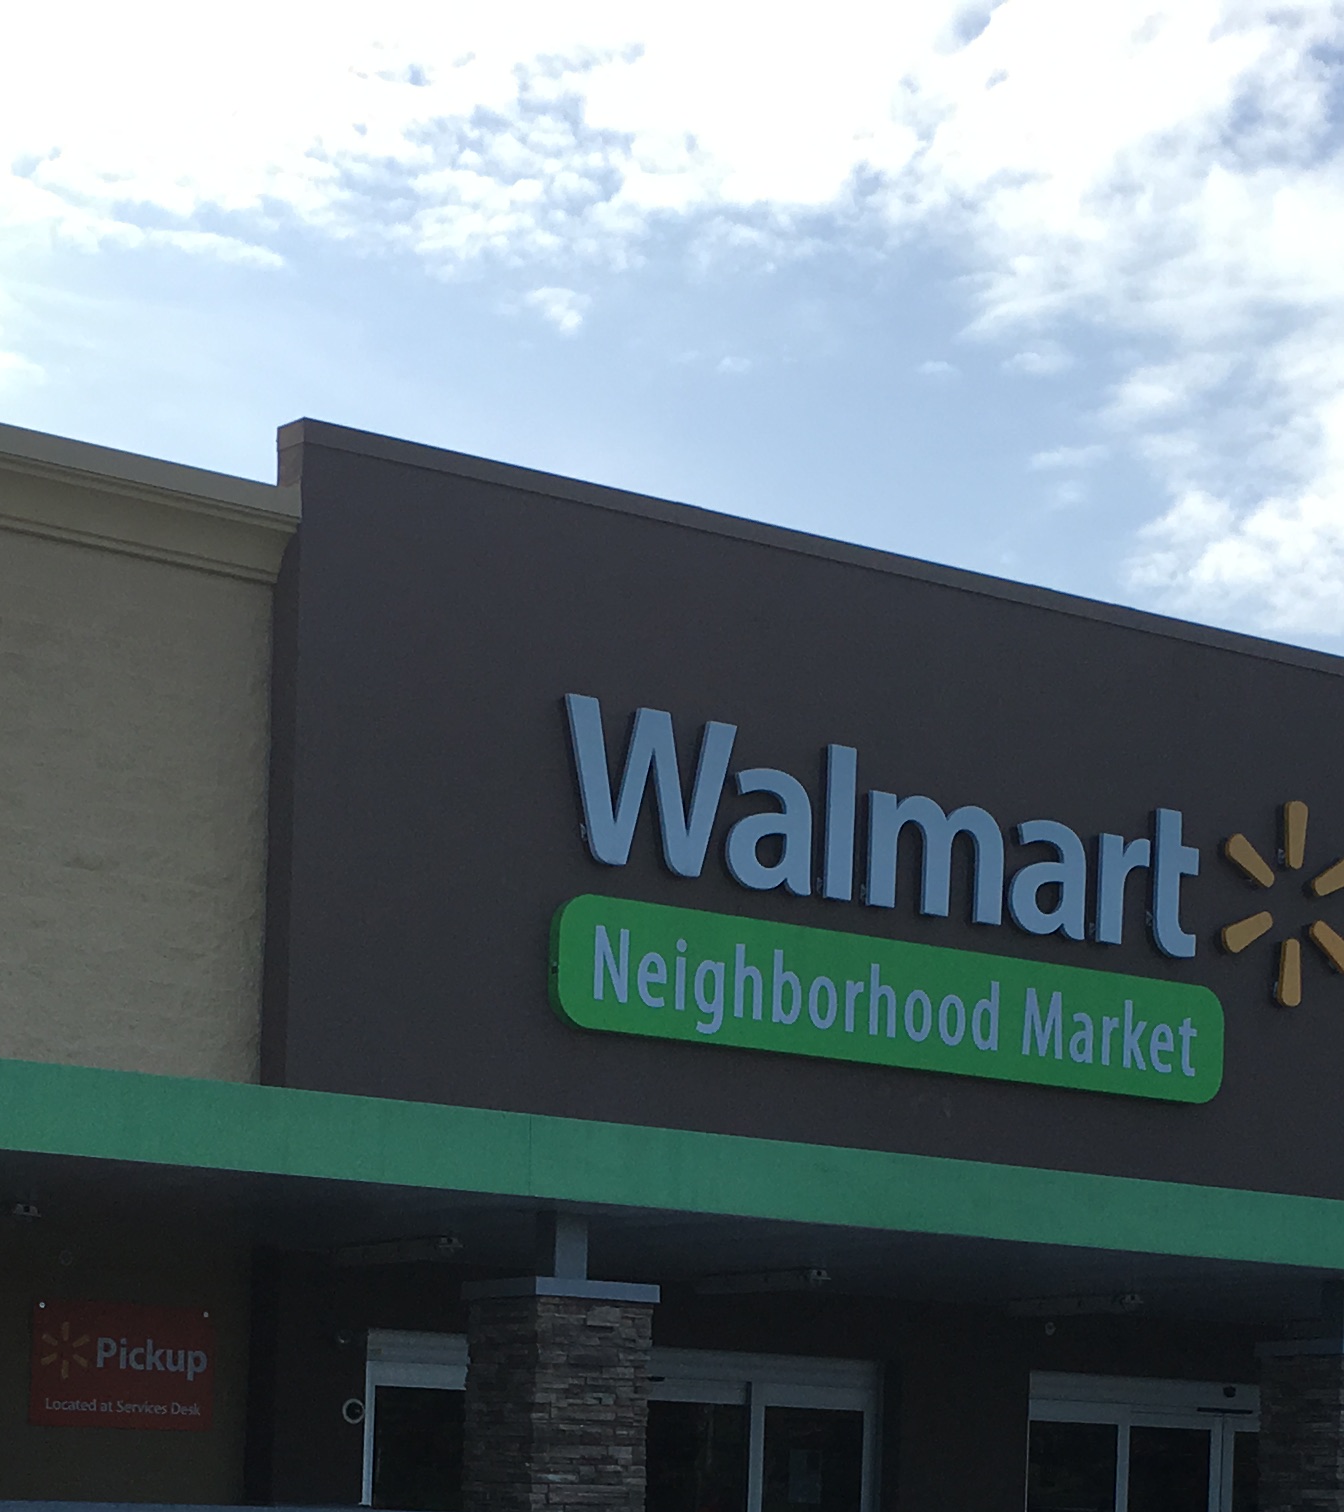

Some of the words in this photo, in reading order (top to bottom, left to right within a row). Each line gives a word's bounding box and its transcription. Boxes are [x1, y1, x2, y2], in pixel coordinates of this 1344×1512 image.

[564, 692, 1199, 958] Walmart
[592, 925, 999, 1053] Neighborhood
[1021, 987, 1199, 1077] Market
[45, 1398, 97, 1412] Located
[100, 1400, 113, 1412] at
[171, 1402, 201, 1416] Desk
[96, 1336, 207, 1381] Pickup
